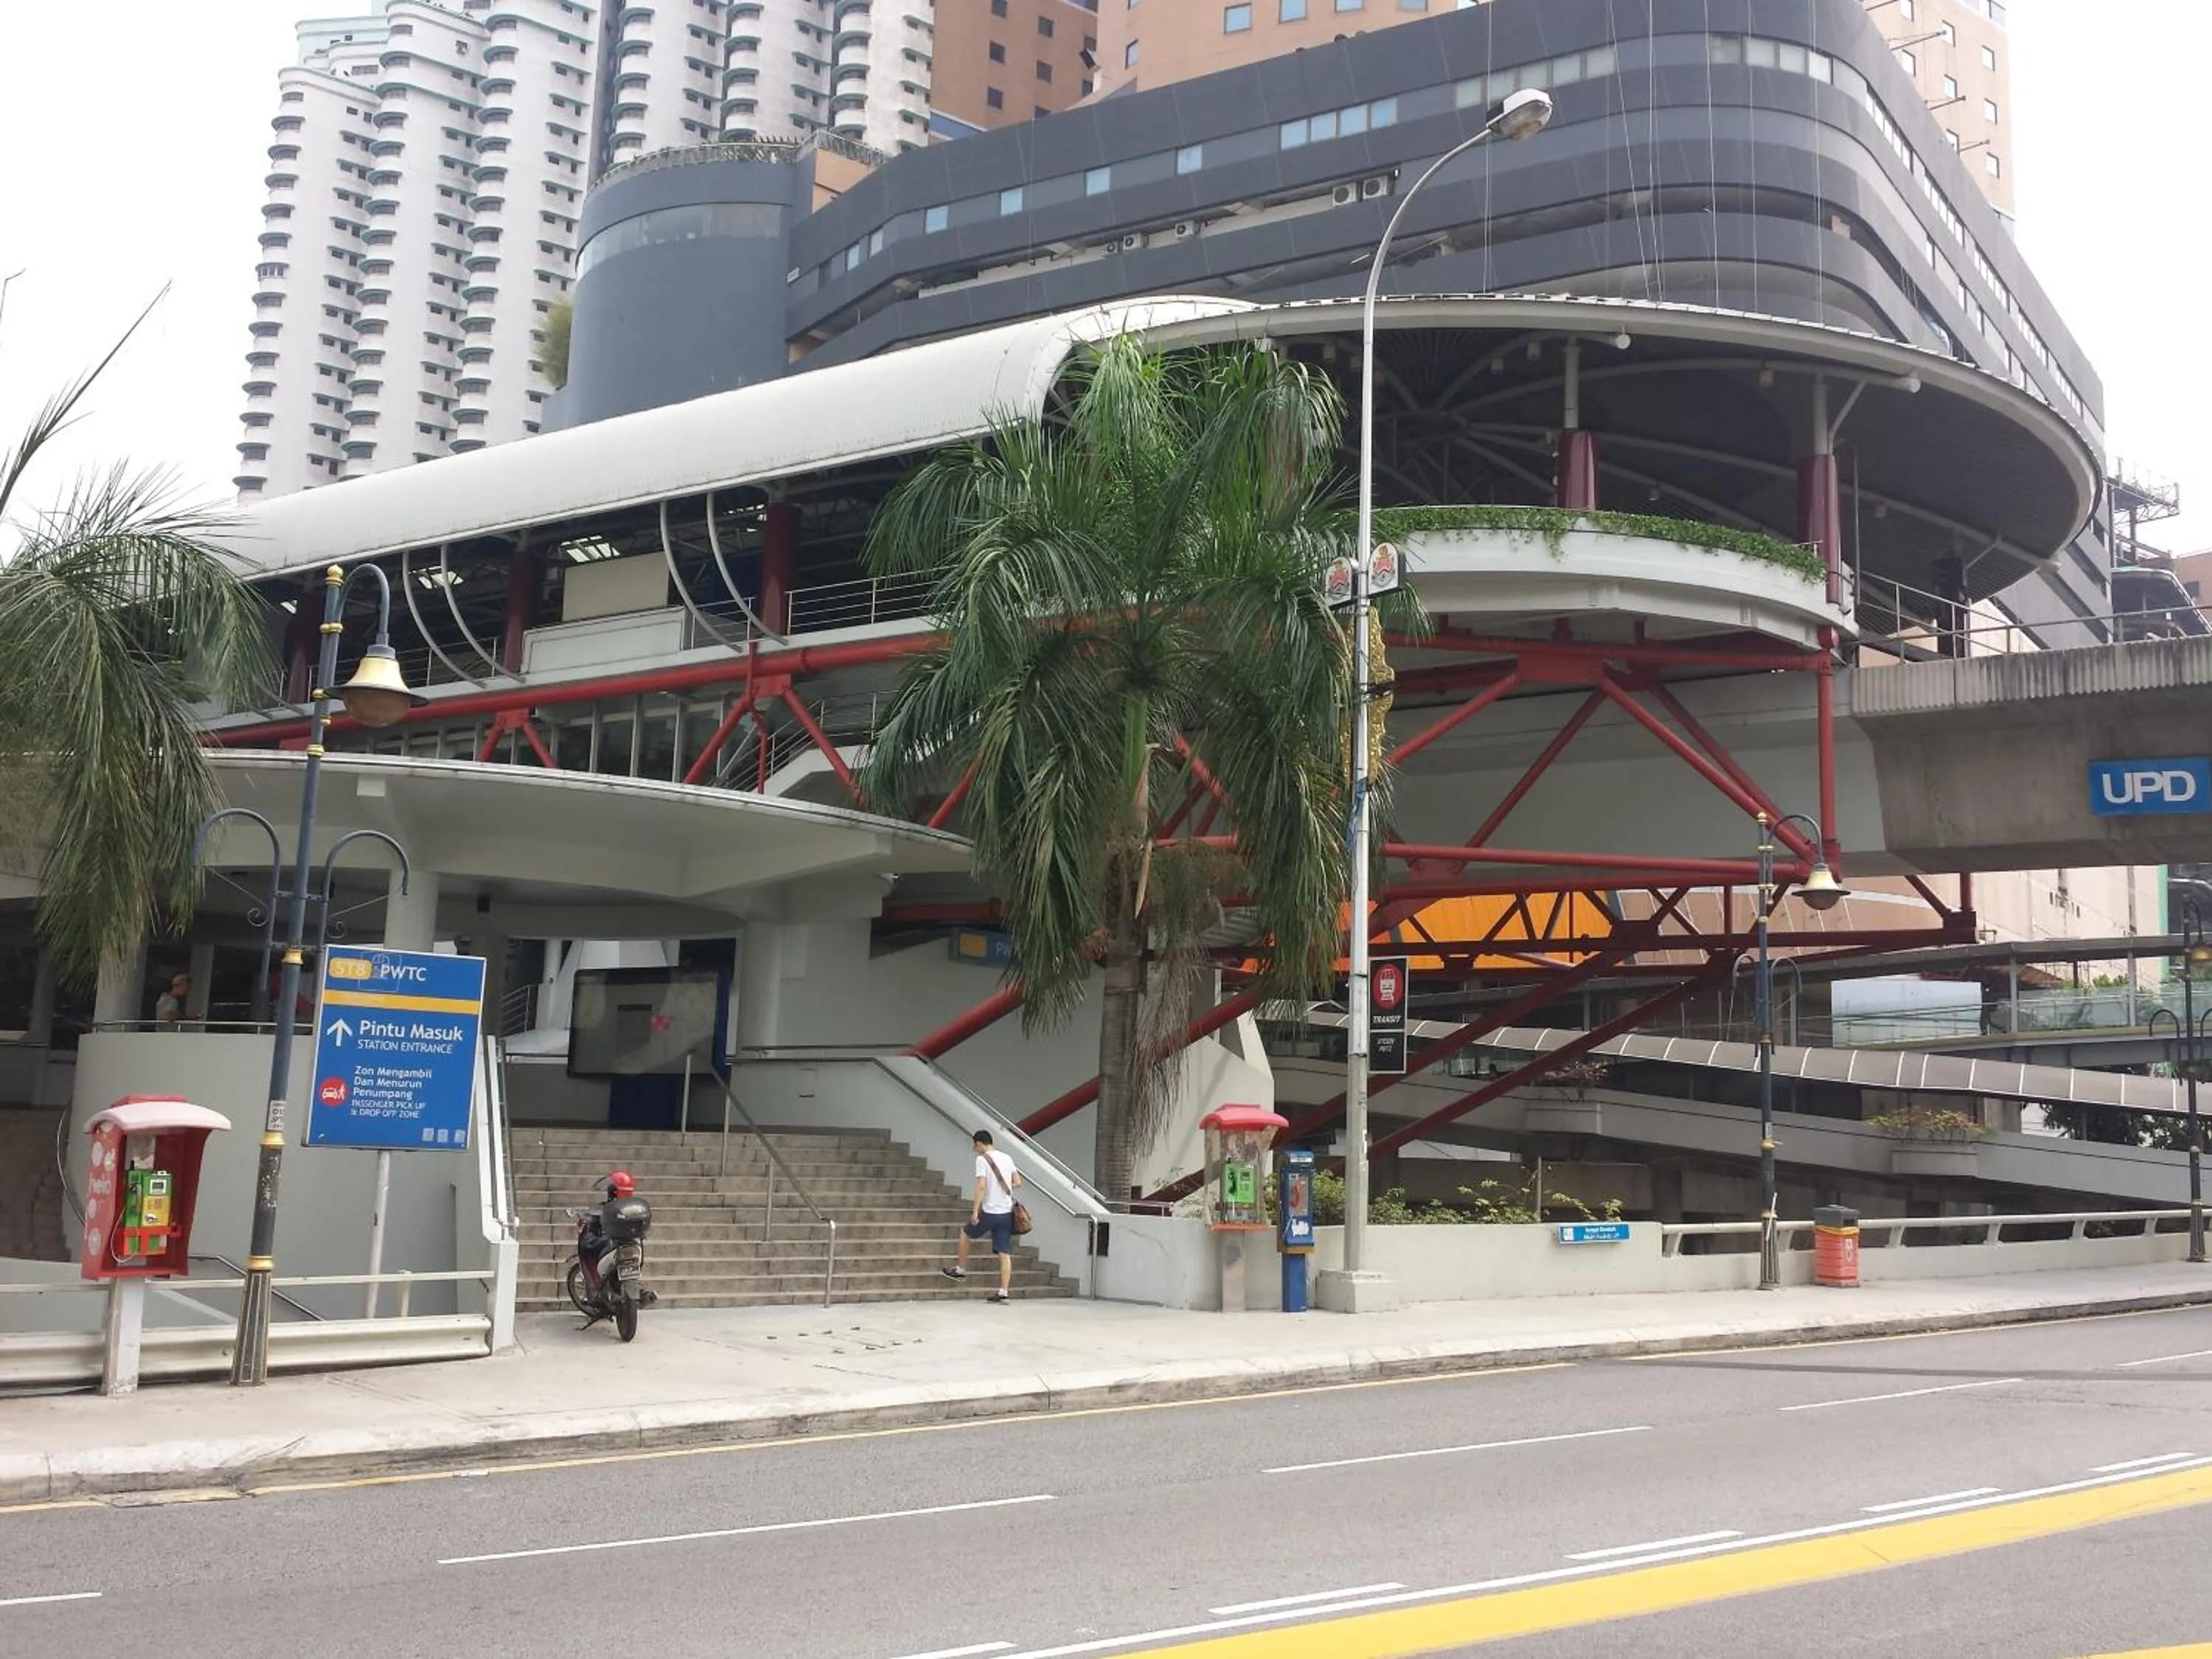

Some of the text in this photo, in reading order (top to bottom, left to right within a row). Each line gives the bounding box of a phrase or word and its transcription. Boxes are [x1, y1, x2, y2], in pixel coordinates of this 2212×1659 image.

[2102, 771, 2197, 804] UPD
[335, 960, 428, 981] ST8 PWTC
[359, 1019, 464, 1041] Pintu Masuk
[358, 1038, 454, 1054] STATION ENTRANCE
[355, 1065, 433, 1079] Zon Mengambil
[354, 1076, 422, 1089] Dan Menurun
[353, 1086, 413, 1100] Penumpang
[352, 1099, 395, 1108] PASSENGER
[359, 1108, 381, 1117] DROP
[399, 1110, 420, 1119] ZONE
